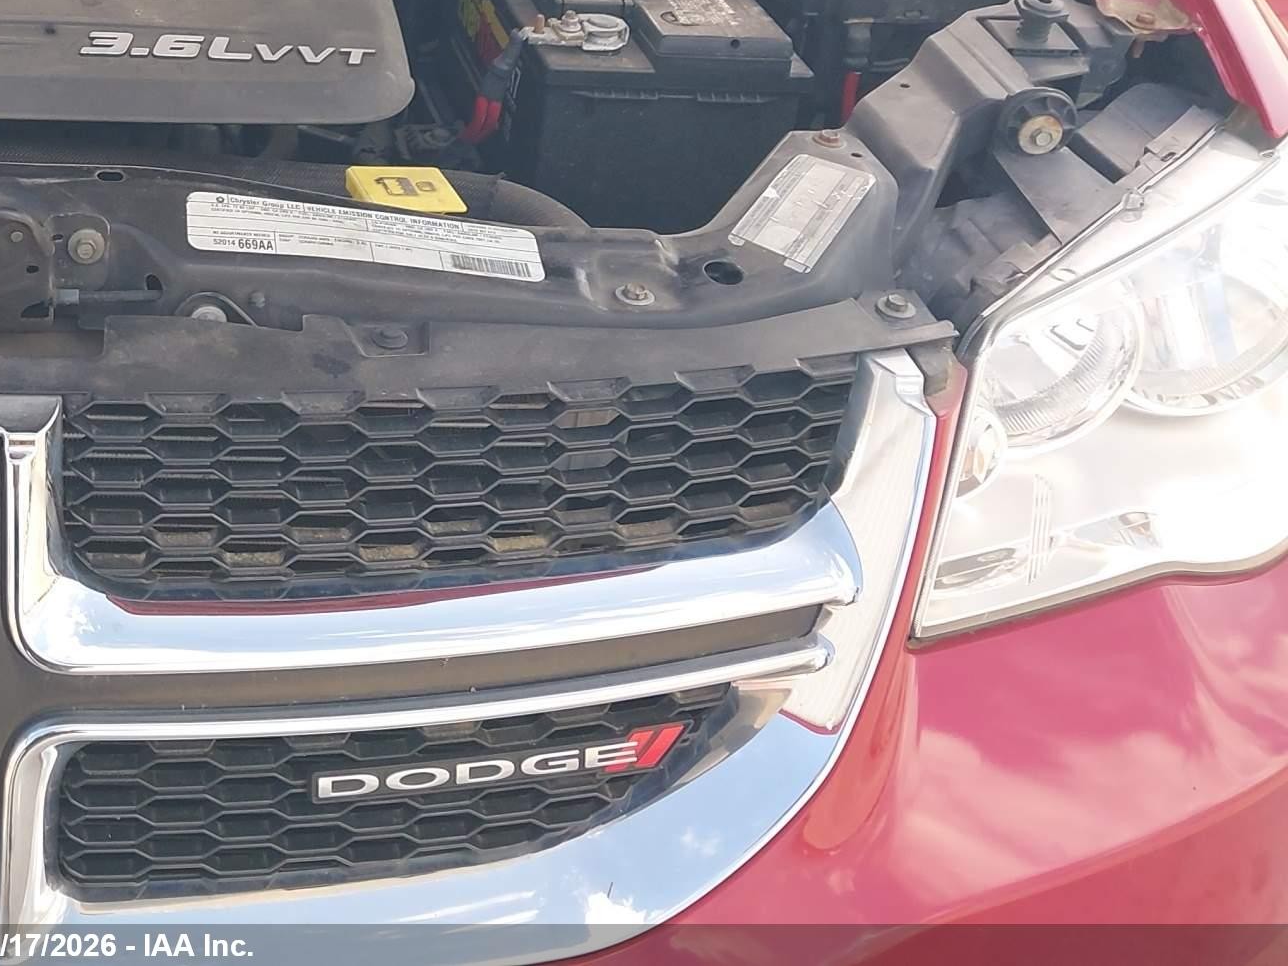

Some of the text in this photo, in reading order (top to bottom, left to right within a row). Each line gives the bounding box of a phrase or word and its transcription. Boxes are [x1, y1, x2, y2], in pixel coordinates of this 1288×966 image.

[230, 197, 301, 210] Chrysler Group LLC
[307, 205, 337, 214] VEHICLE
[338, 209, 373, 219] EMISSION
[375, 213, 406, 223] CONTROL
[410, 217, 460, 230] INFORMATION
[212, 238, 236, 246] 52014
[237, 238, 274, 251] 669AA
[317, 740, 639, 799] DODGE
